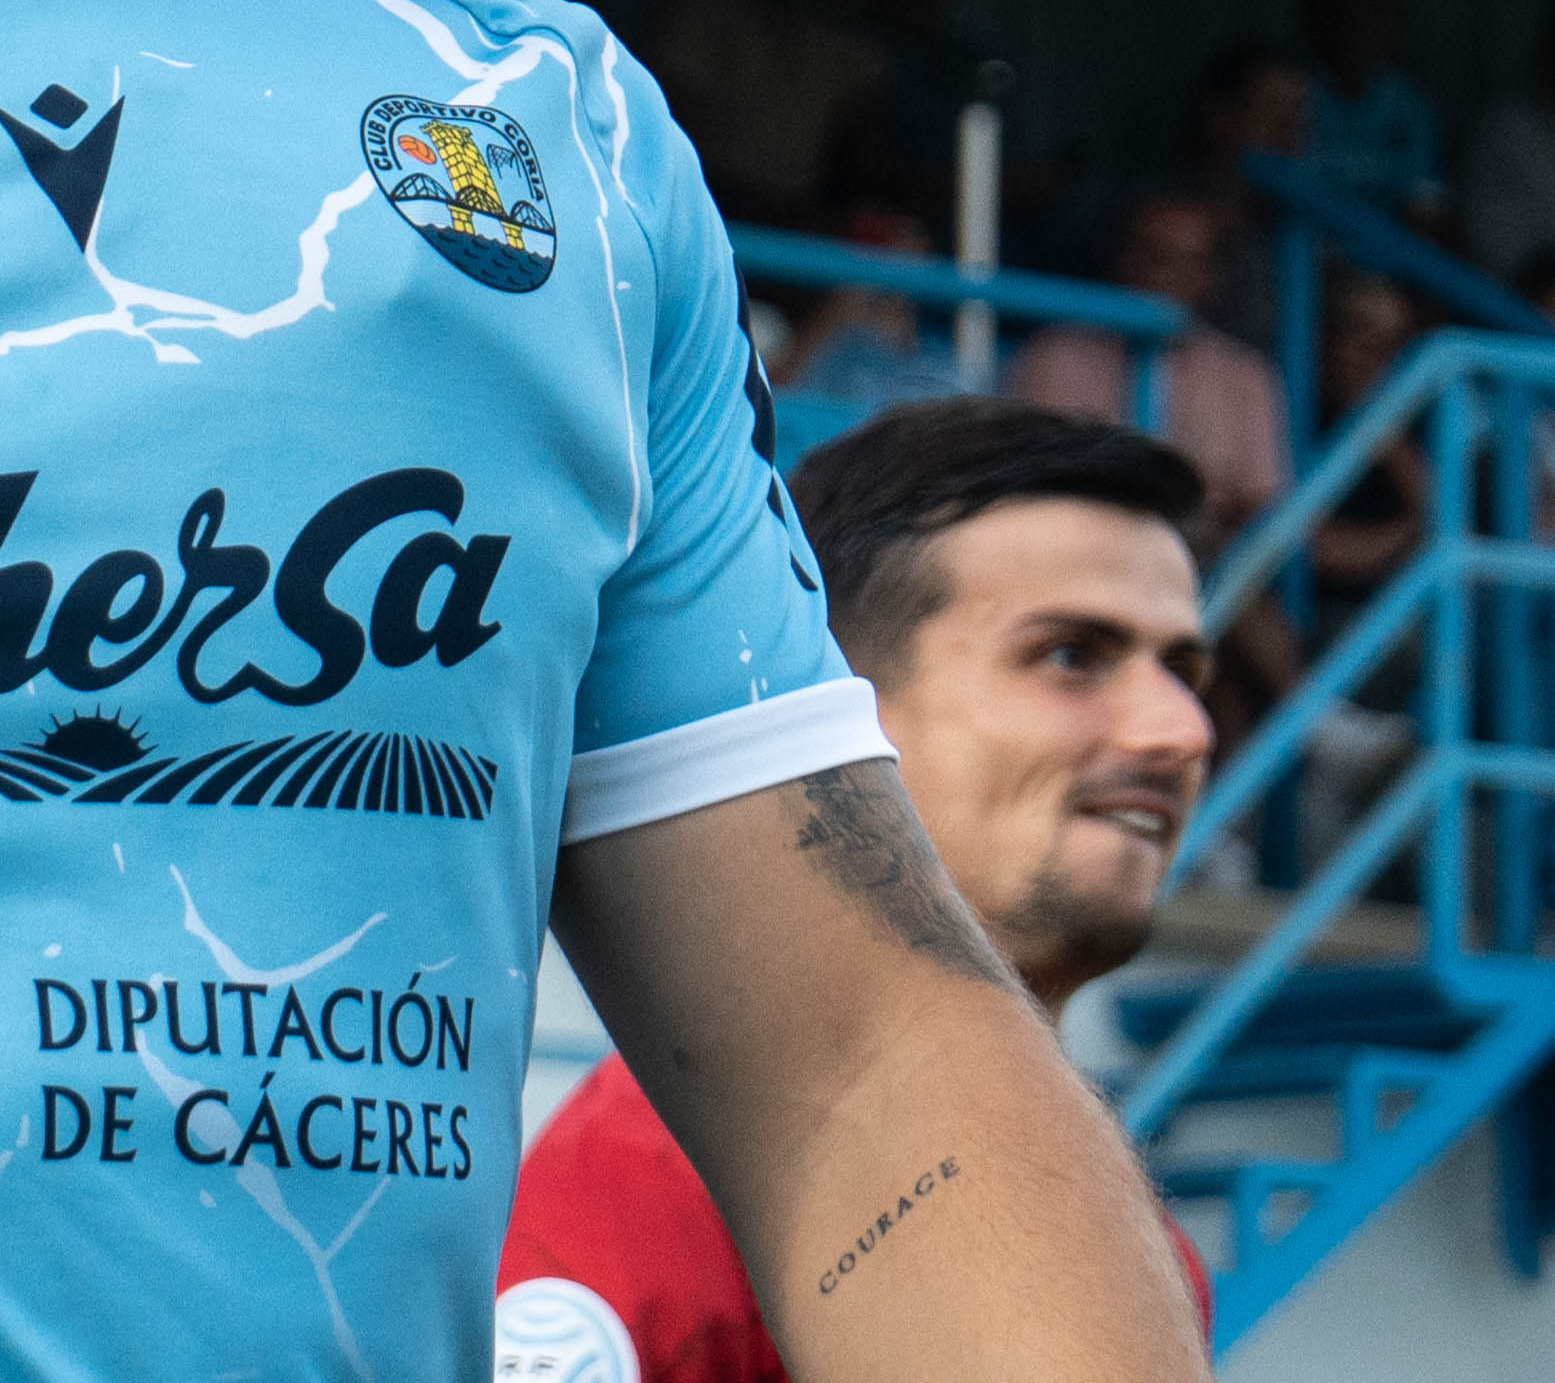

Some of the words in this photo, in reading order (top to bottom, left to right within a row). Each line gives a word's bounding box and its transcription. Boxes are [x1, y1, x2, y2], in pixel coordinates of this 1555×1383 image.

[368, 119, 393, 171] CLUB
[375, 99, 496, 124] DEPORTIVO
[504, 123, 544, 202] CORIA
[34, 972, 474, 1073] DIPUTACIÓN
[41, 1084, 137, 1163] DE
[174, 1074, 471, 1180] CÁCERES
